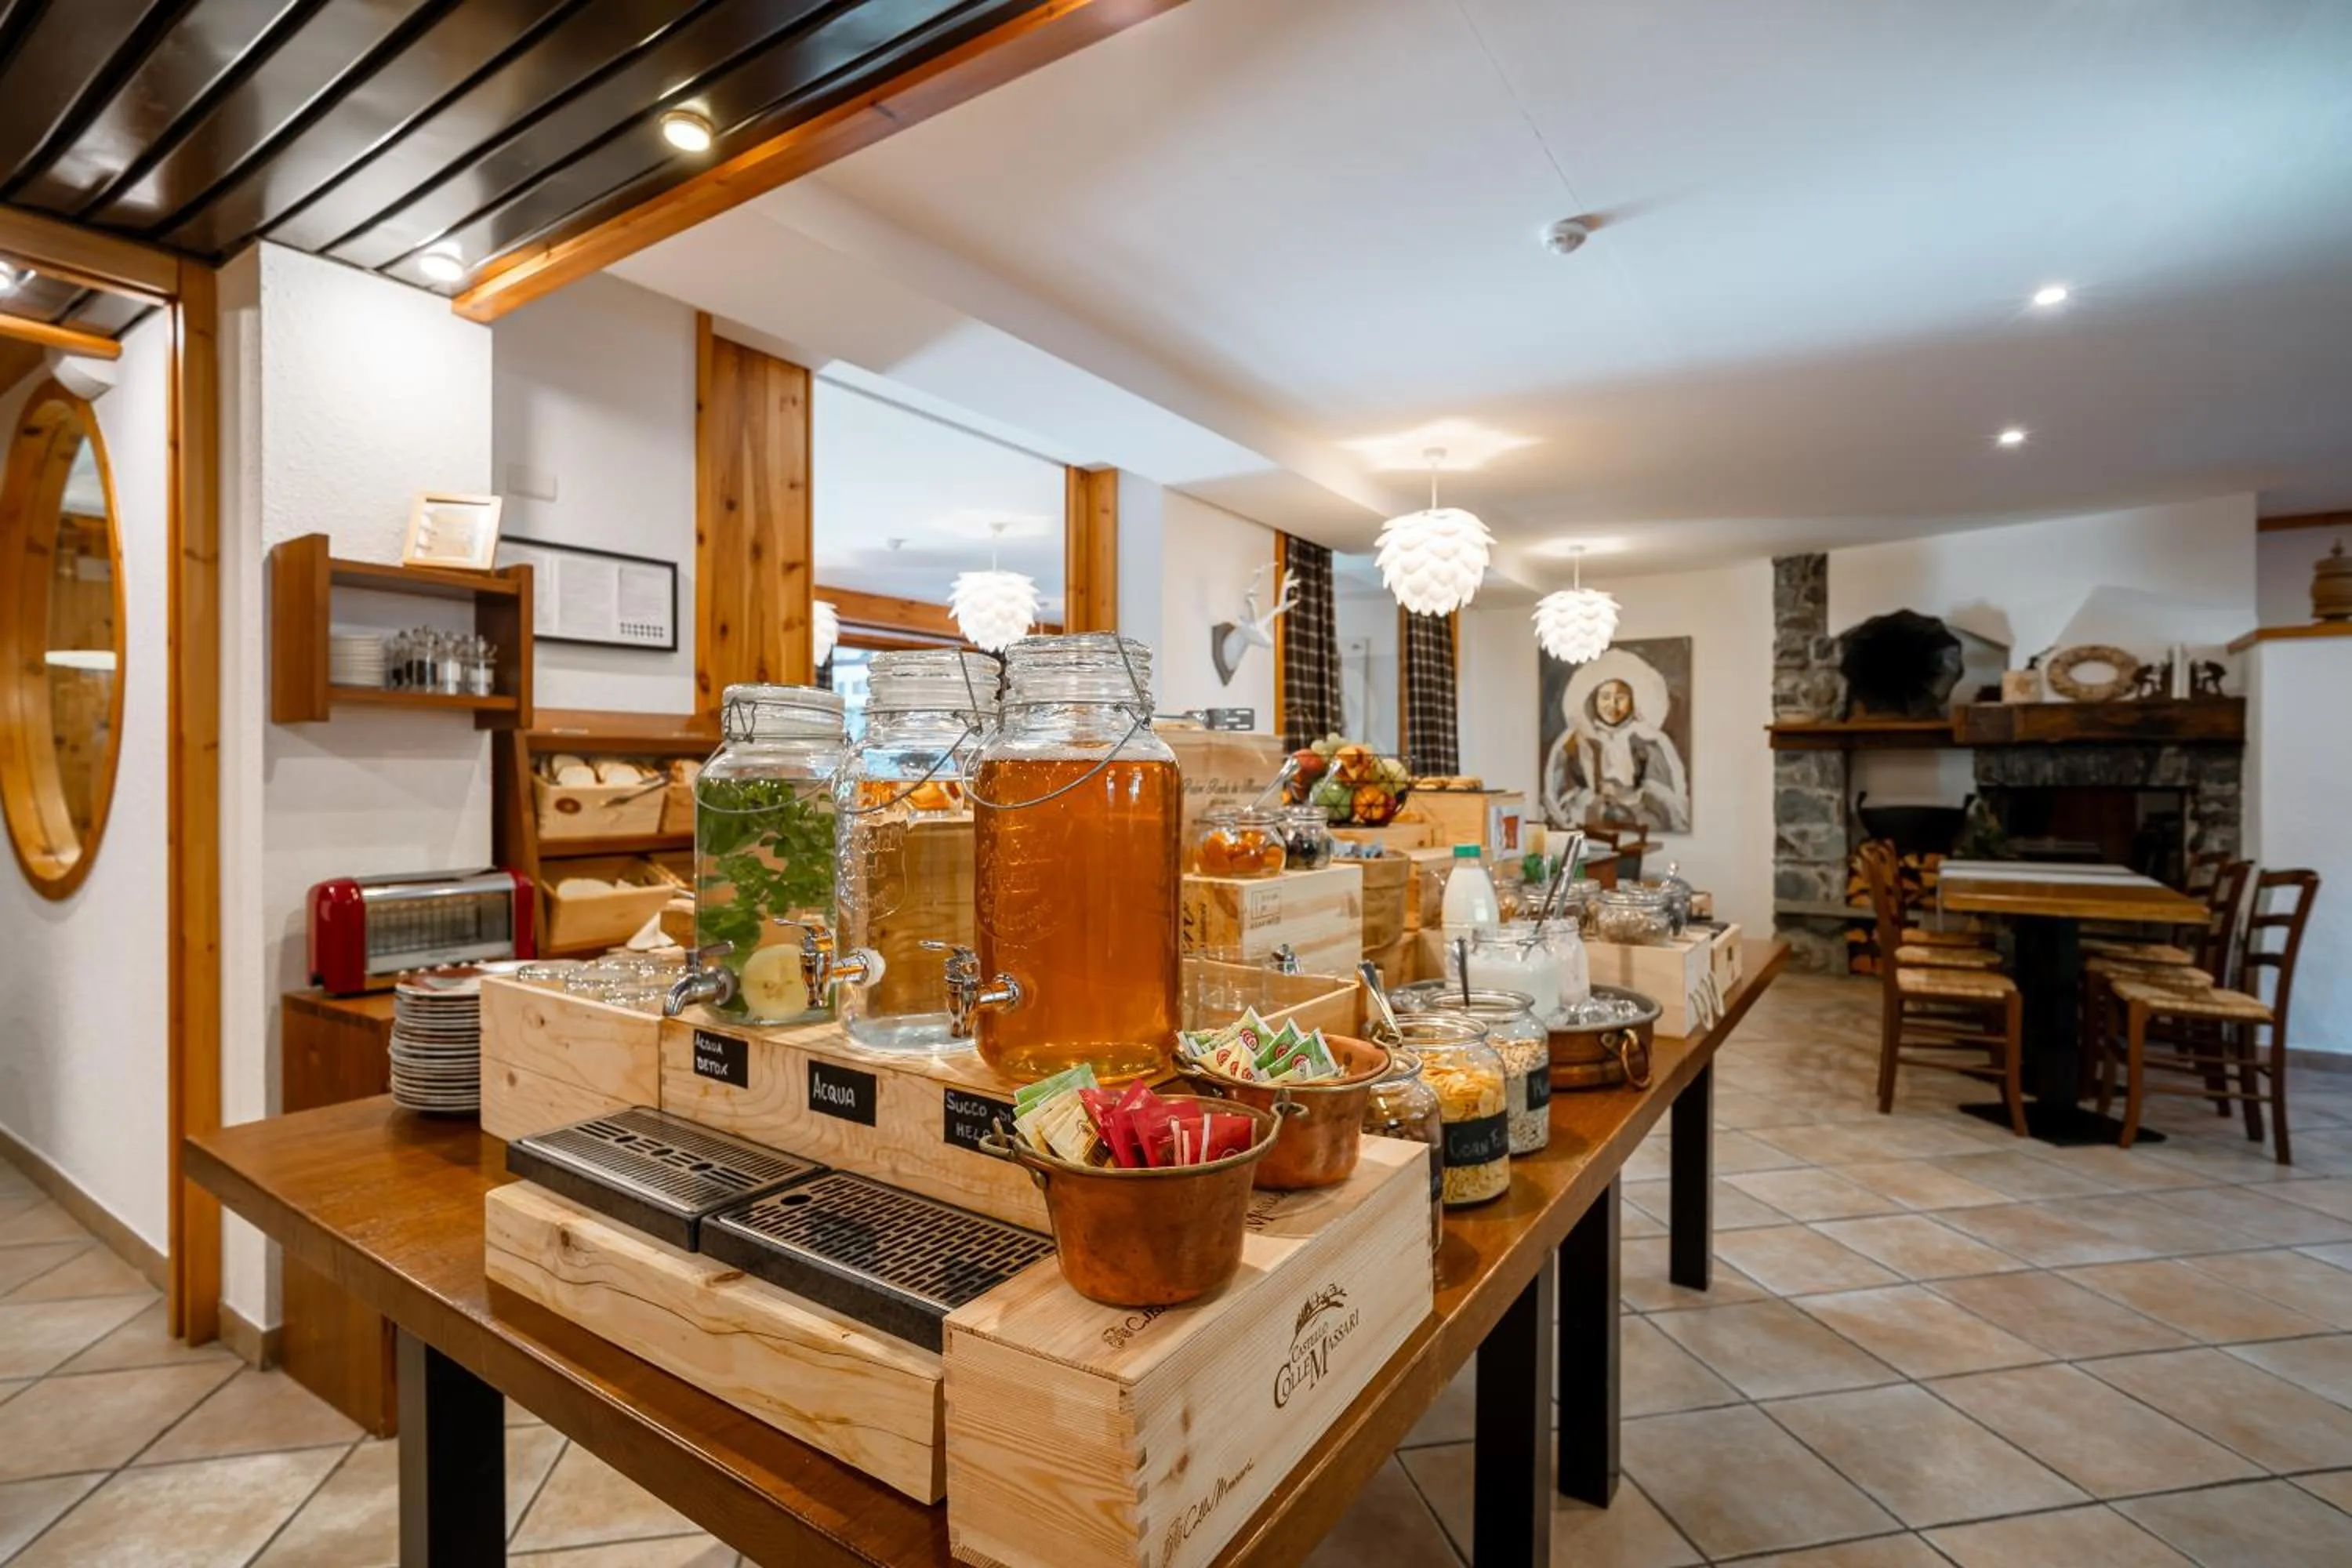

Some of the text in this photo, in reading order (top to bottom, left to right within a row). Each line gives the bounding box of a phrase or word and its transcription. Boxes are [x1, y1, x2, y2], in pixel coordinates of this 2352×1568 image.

[696, 1056, 728, 1076] DETOX
[812, 1071, 856, 1108] ACQUA
[946, 1091, 987, 1117] SUCCO
[1291, 1322, 1329, 1363] CASTELLO
